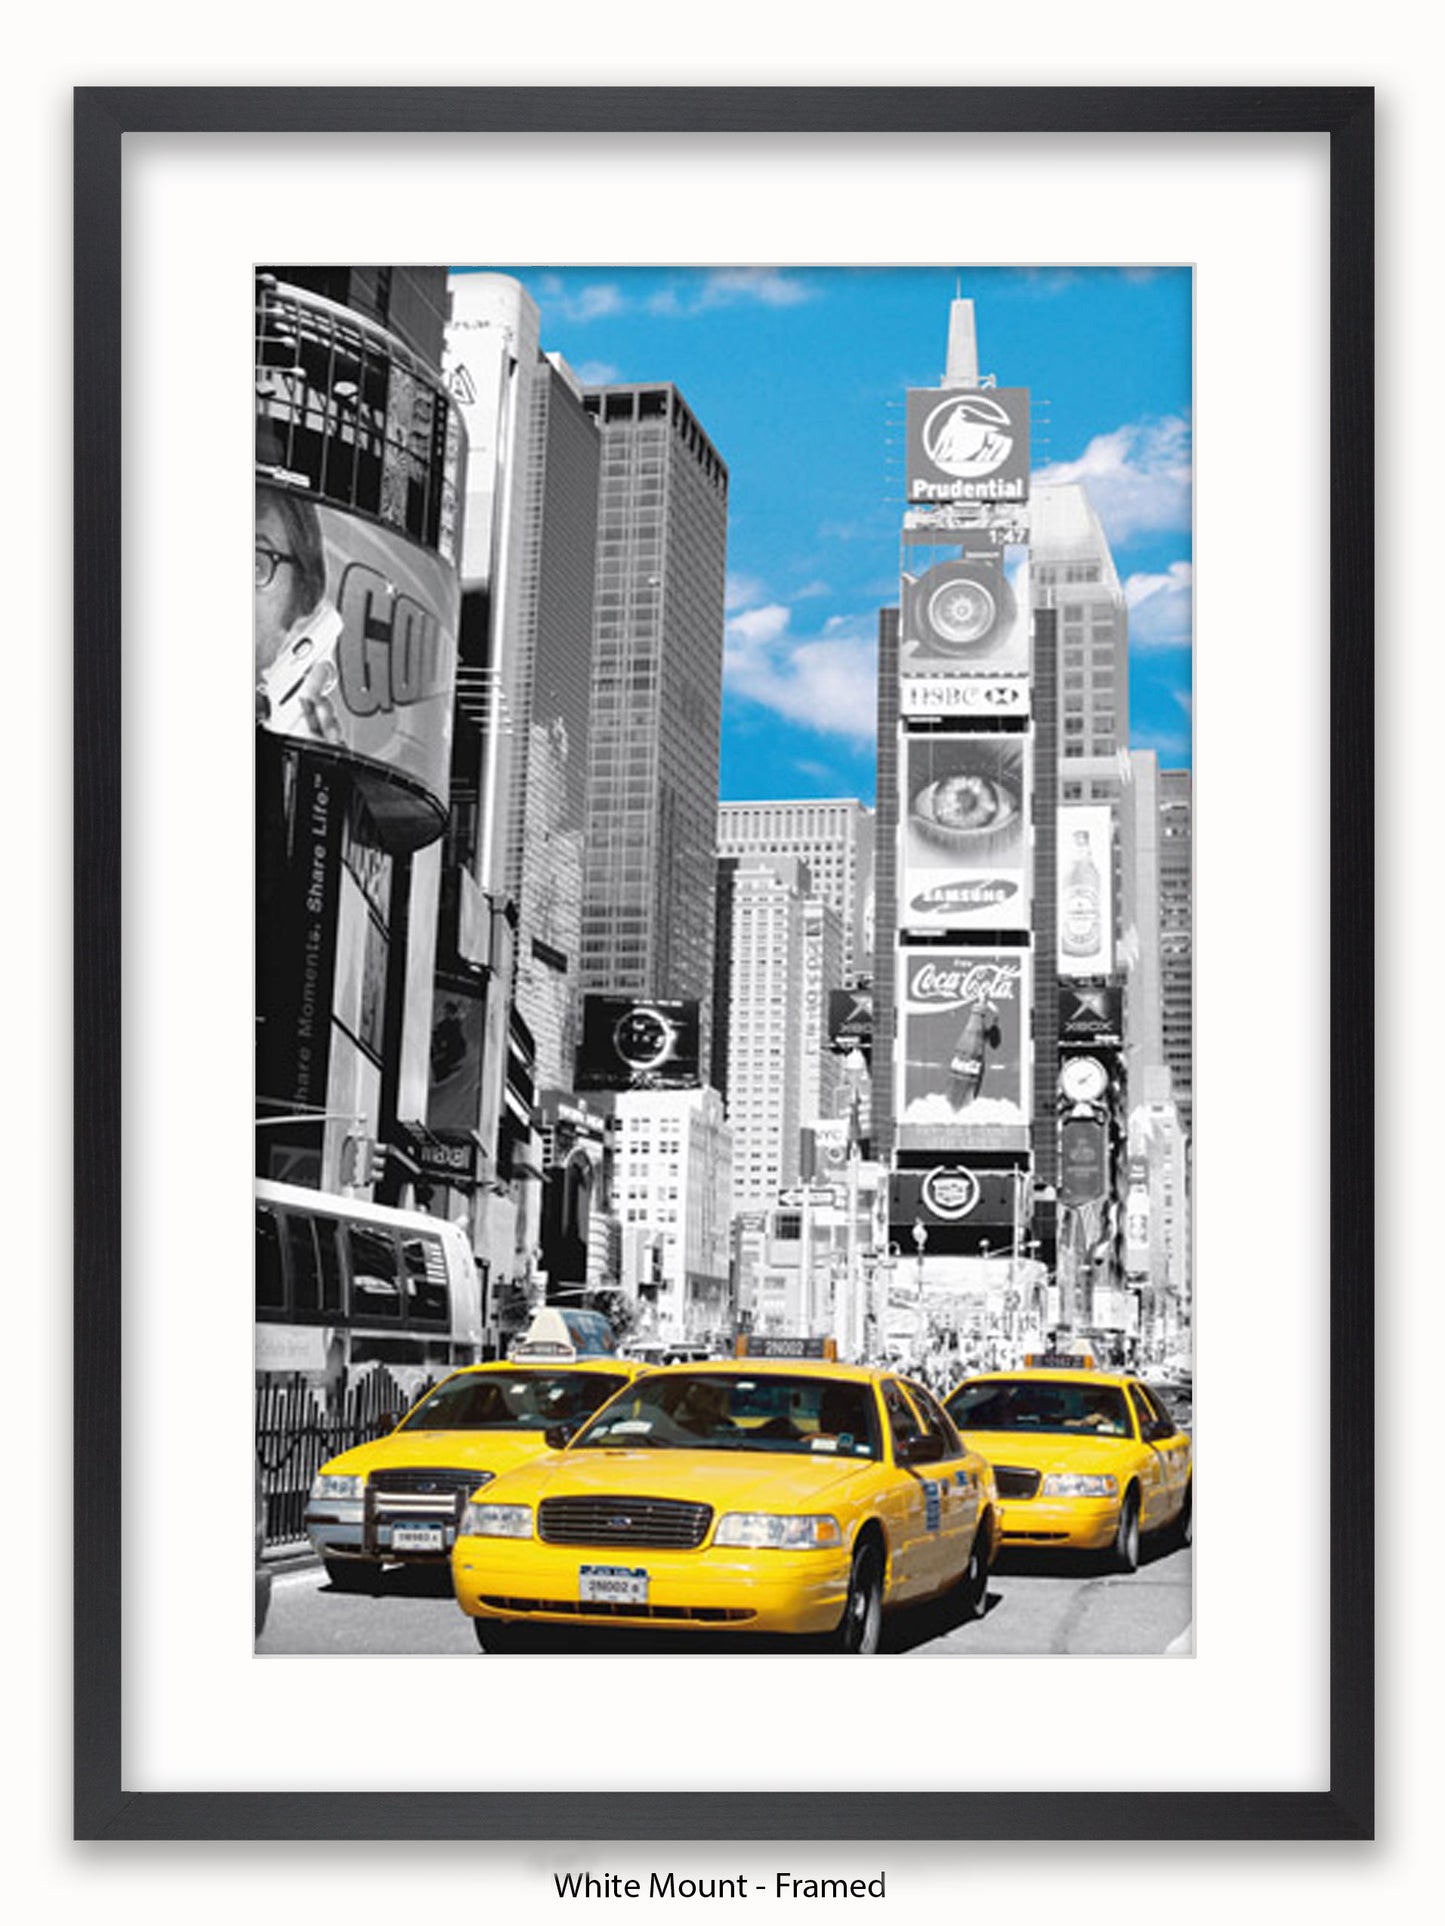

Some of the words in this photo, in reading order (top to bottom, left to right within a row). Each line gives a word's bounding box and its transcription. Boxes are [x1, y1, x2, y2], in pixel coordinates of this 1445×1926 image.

[912, 478, 1024, 499] Prudential
[989, 529, 1026, 545] 1:47
[910, 687, 980, 706] HSBC
[306, 844, 327, 913] Share
[922, 887, 1006, 903] SAMSUNG
[1064, 1020, 1113, 1032] XBOX
